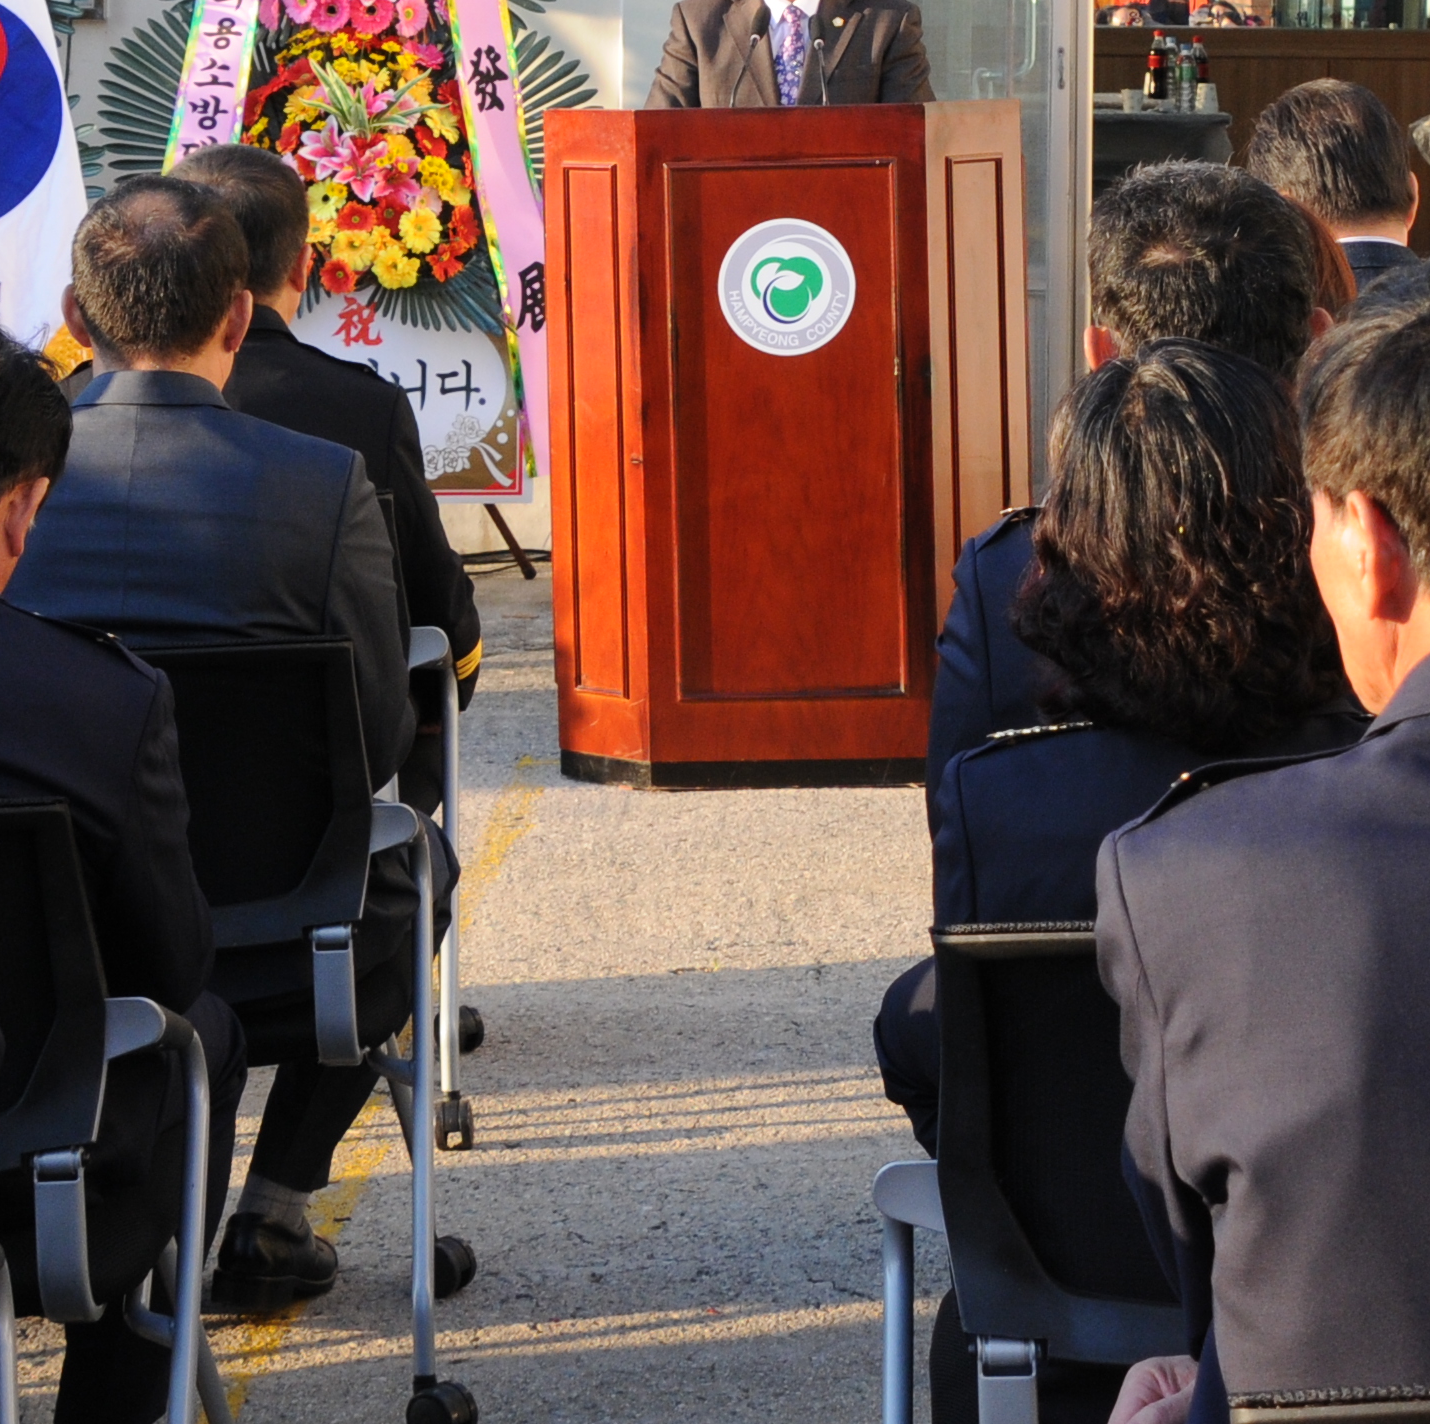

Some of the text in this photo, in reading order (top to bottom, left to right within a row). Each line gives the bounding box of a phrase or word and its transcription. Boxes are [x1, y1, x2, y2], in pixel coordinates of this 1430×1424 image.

[332, 296, 384, 347] 祝
[729, 289, 846, 346] HAMPYEONG COUNTY
